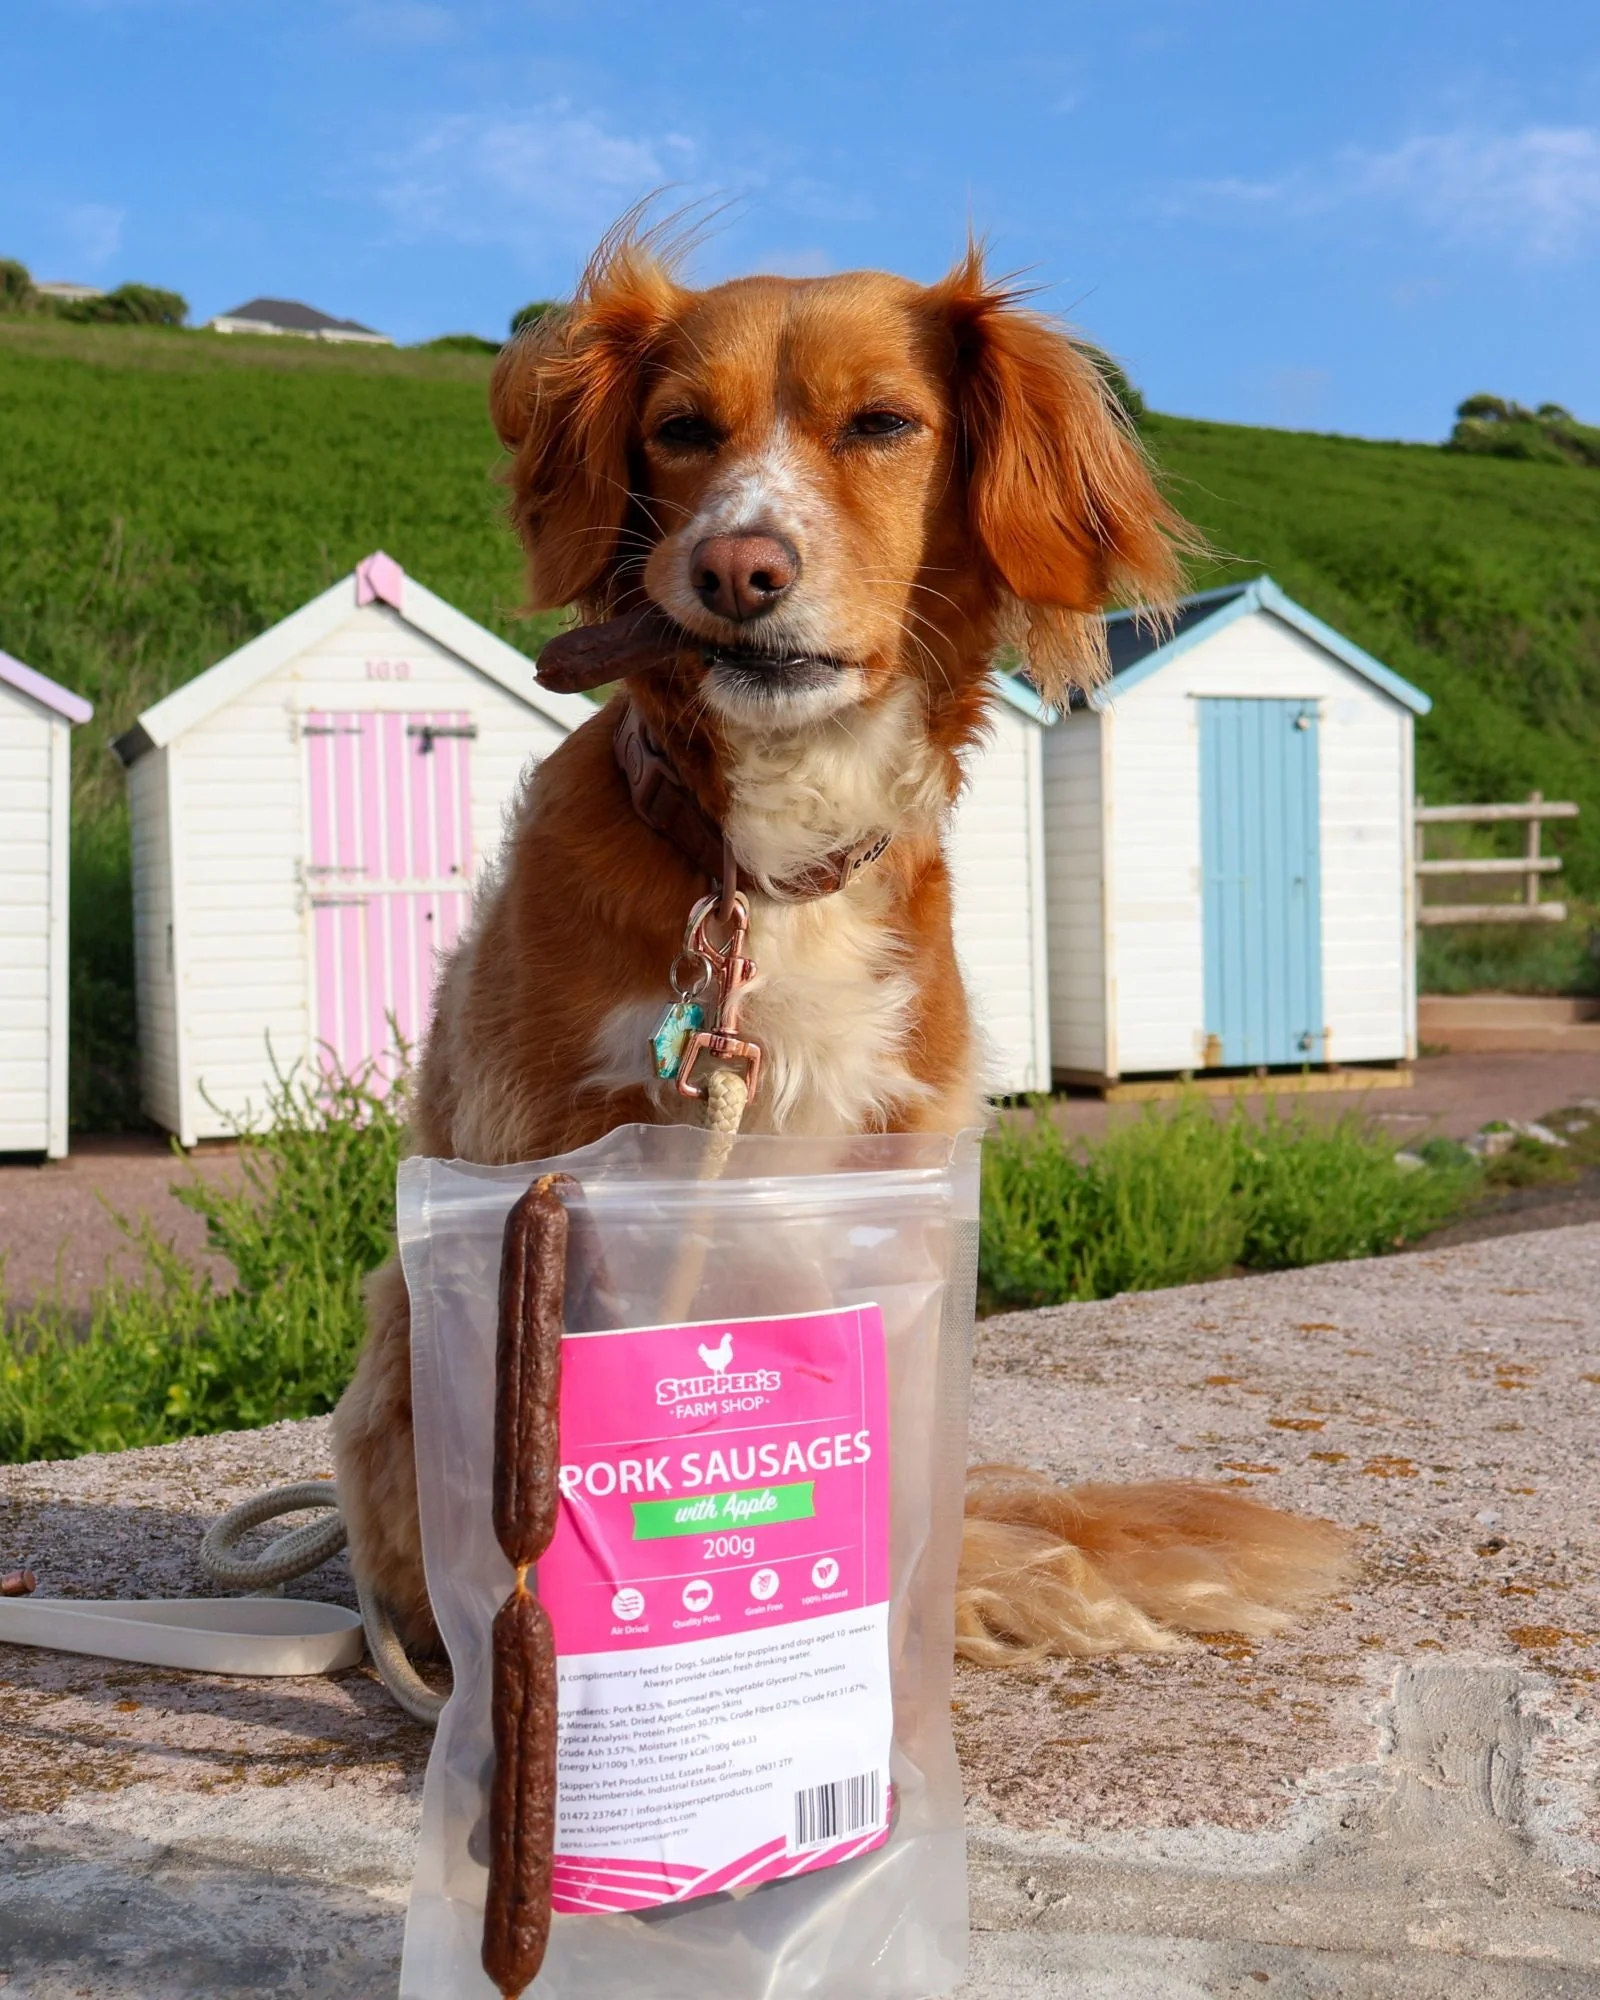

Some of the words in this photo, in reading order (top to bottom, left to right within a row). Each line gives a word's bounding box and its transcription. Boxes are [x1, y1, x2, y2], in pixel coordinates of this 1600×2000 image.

[656, 1369, 781, 1405] SKIPPER'S
[675, 1401, 717, 1419] FARM
[721, 1396, 764, 1414] SHOP
[559, 1456, 672, 1497] PORK
[681, 1430, 871, 1487] SAUSAGES
[675, 1495, 718, 1524] with
[722, 1488, 778, 1522] Apple
[703, 1535, 755, 1560] 200g
[745, 1606, 766, 1616] Grain
[767, 1602, 784, 1613] Free
[801, 1595, 821, 1606] 100%
[821, 1588, 848, 1602] Natural
[611, 1626, 624, 1635] Air
[625, 1624, 649, 1635] Dried
[672, 1616, 702, 1629] Quality
[703, 1613, 721, 1624] Pork
[560, 1674, 566, 1682] A
[568, 1668, 636, 1682] complimentary
[640, 1665, 659, 1675] feed
[661, 1662, 673, 1672] for
[675, 1659, 697, 1673] Dogs.
[700, 1651, 733, 1665] Suitable
[735, 1650, 745, 1660] for
[747, 1644, 779, 1657] puppies
[780, 1640, 795, 1650] and
[796, 1636, 815, 1648] dogs
[816, 1631, 835, 1644] aged
[643, 1678, 674, 1689] Always
[675, 1672, 707, 1685] provide
[733, 1661, 753, 1673] fresh
[755, 1655, 787, 1668] drinking
[613, 1704, 633, 1714] Pork
[667, 1692, 708, 1707] Bonemeal
[725, 1678, 764, 1695] Vegetable
[766, 1671, 797, 1687] Glycerol
[814, 1663, 846, 1676] Vitamins
[591, 1733, 632, 1743] Analysis:
[633, 1728, 665, 1739] Protein
[667, 1723, 697, 1734] Protein
[730, 1710, 753, 1720] Crude
[755, 1704, 775, 1715] Fibre
[802, 1692, 825, 1704] Crude
[826, 1688, 838, 1698] Fat
[631, 1716, 656, 1726] Dried
[685, 1703, 721, 1717] Collagen
[721, 1699, 743, 1709] Skins
[558, 1748, 585, 1757] Crude
[588, 1748, 604, 1756] Ash
[639, 1740, 678, 1752] Moisture
[558, 1763, 589, 1772] Energy
[658, 1751, 688, 1763] Energy
[559, 1781, 600, 1792] Skipper's
[602, 1779, 617, 1789] Pet
[619, 1774, 658, 1786] Products
[678, 1767, 704, 1778] Estate
[706, 1761, 726, 1773] Road
[560, 1793, 587, 1802] South
[648, 1782, 689, 1795] Industrial
[560, 1812, 589, 1821] 01472
[592, 1808, 628, 1820] 237647
[636, 1781, 773, 1815] info@skipperspetproducts.com
[560, 1811, 697, 1834] www.skipperspetproducts.com
